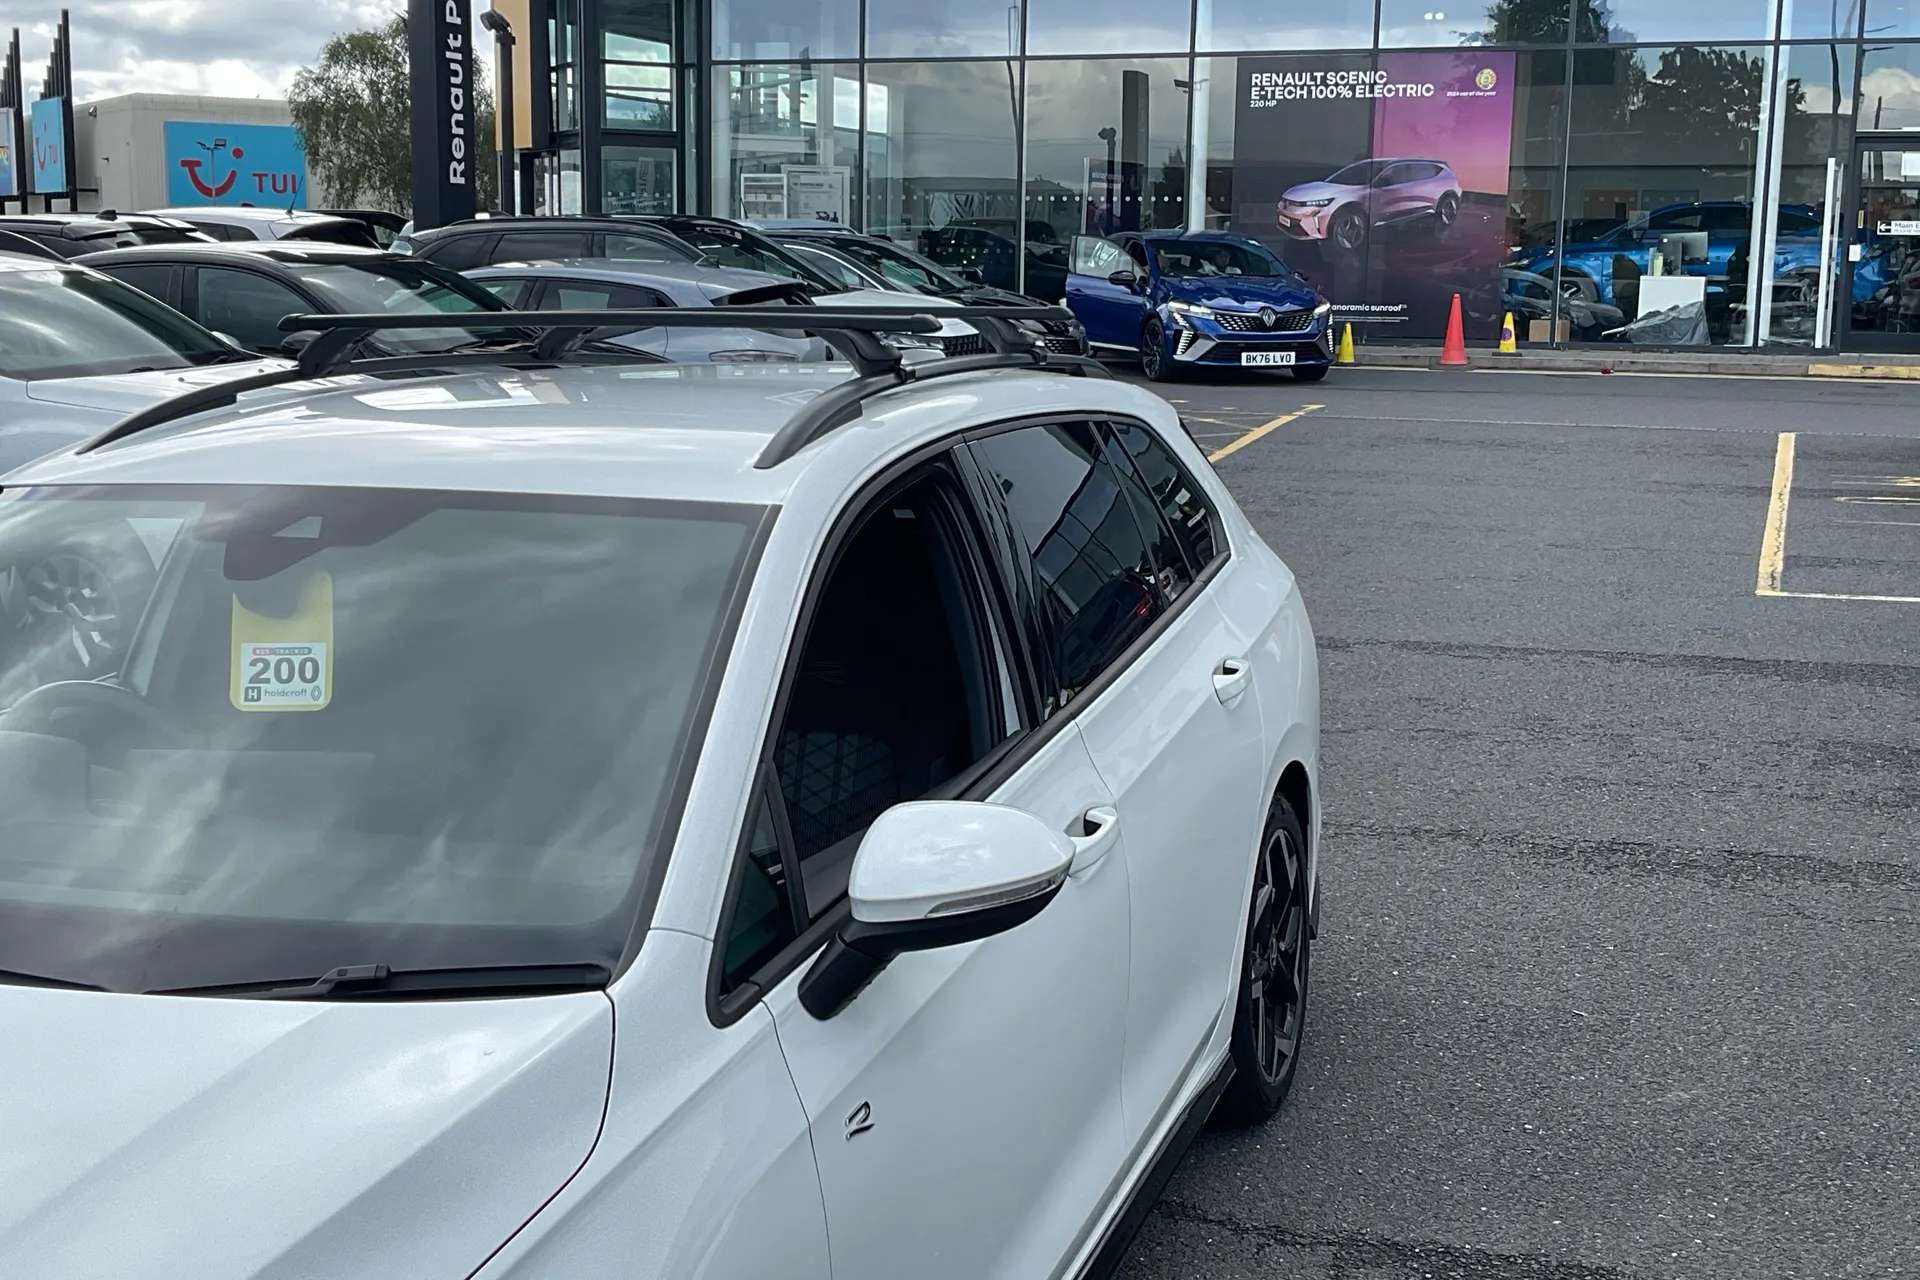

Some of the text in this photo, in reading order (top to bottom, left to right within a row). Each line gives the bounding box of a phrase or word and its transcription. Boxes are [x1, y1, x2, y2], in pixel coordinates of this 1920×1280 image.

[1251, 71, 1388, 86] RENAULT SCENIC
[1250, 84, 1435, 99] E-TECH 100% ELECTRIC
[446, 33, 465, 184] Renault
[252, 172, 297, 194] TUI
[248, 657, 320, 684] 200
